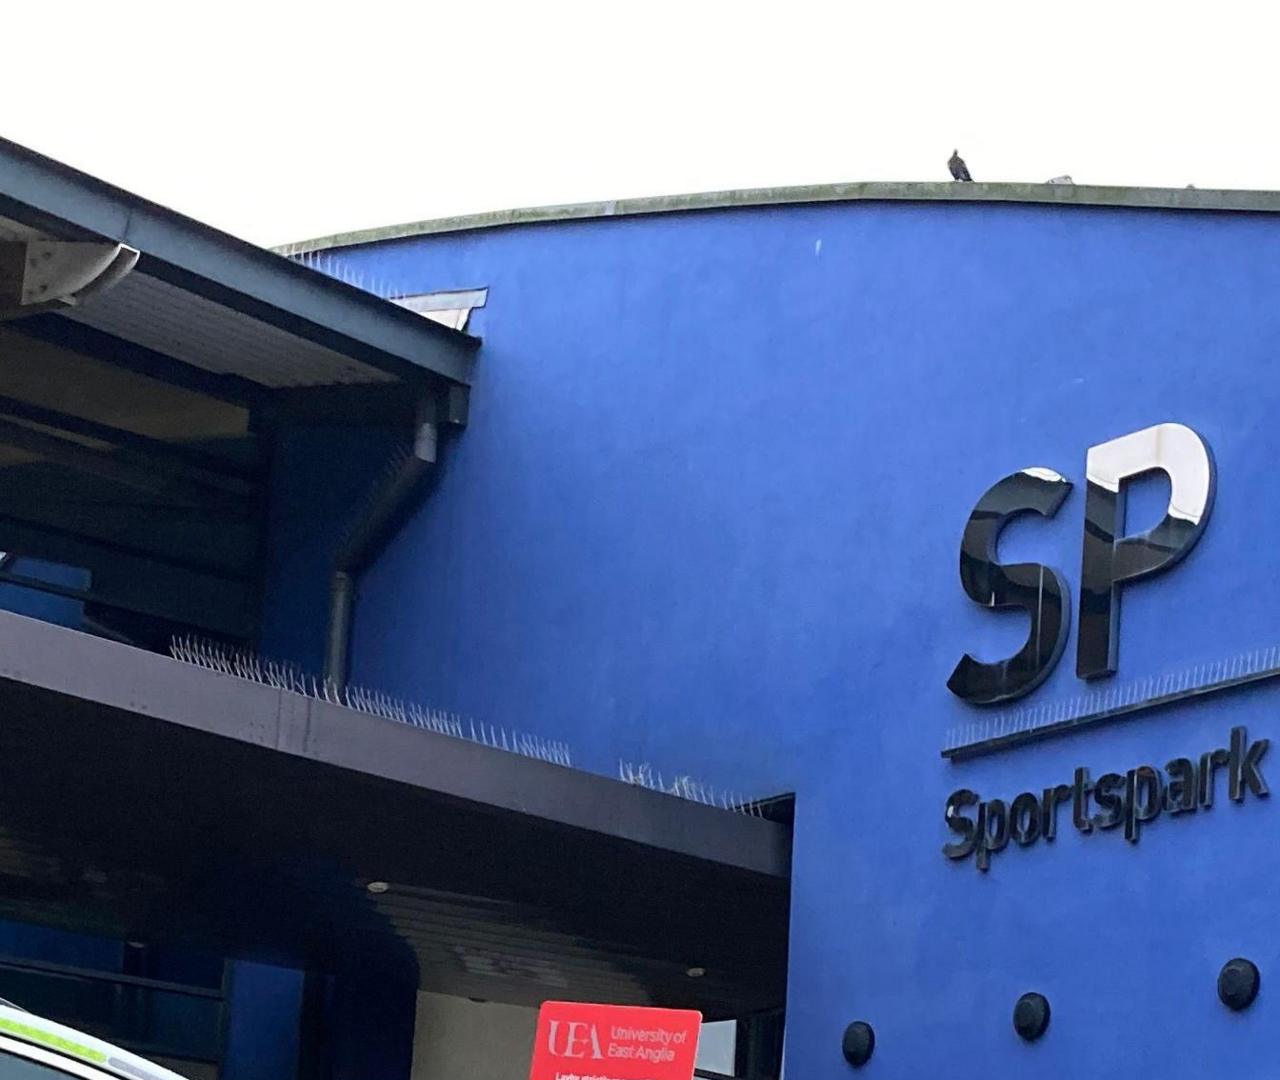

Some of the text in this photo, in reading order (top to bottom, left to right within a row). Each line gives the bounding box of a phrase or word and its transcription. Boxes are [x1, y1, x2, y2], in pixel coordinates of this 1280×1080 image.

[946, 422, 1217, 704] SP
[942, 725, 1272, 871] Sportspark
[548, 1019, 605, 1060] UEA
[608, 1042, 676, 1064] East Anglia
[611, 1025, 688, 1046] University of
